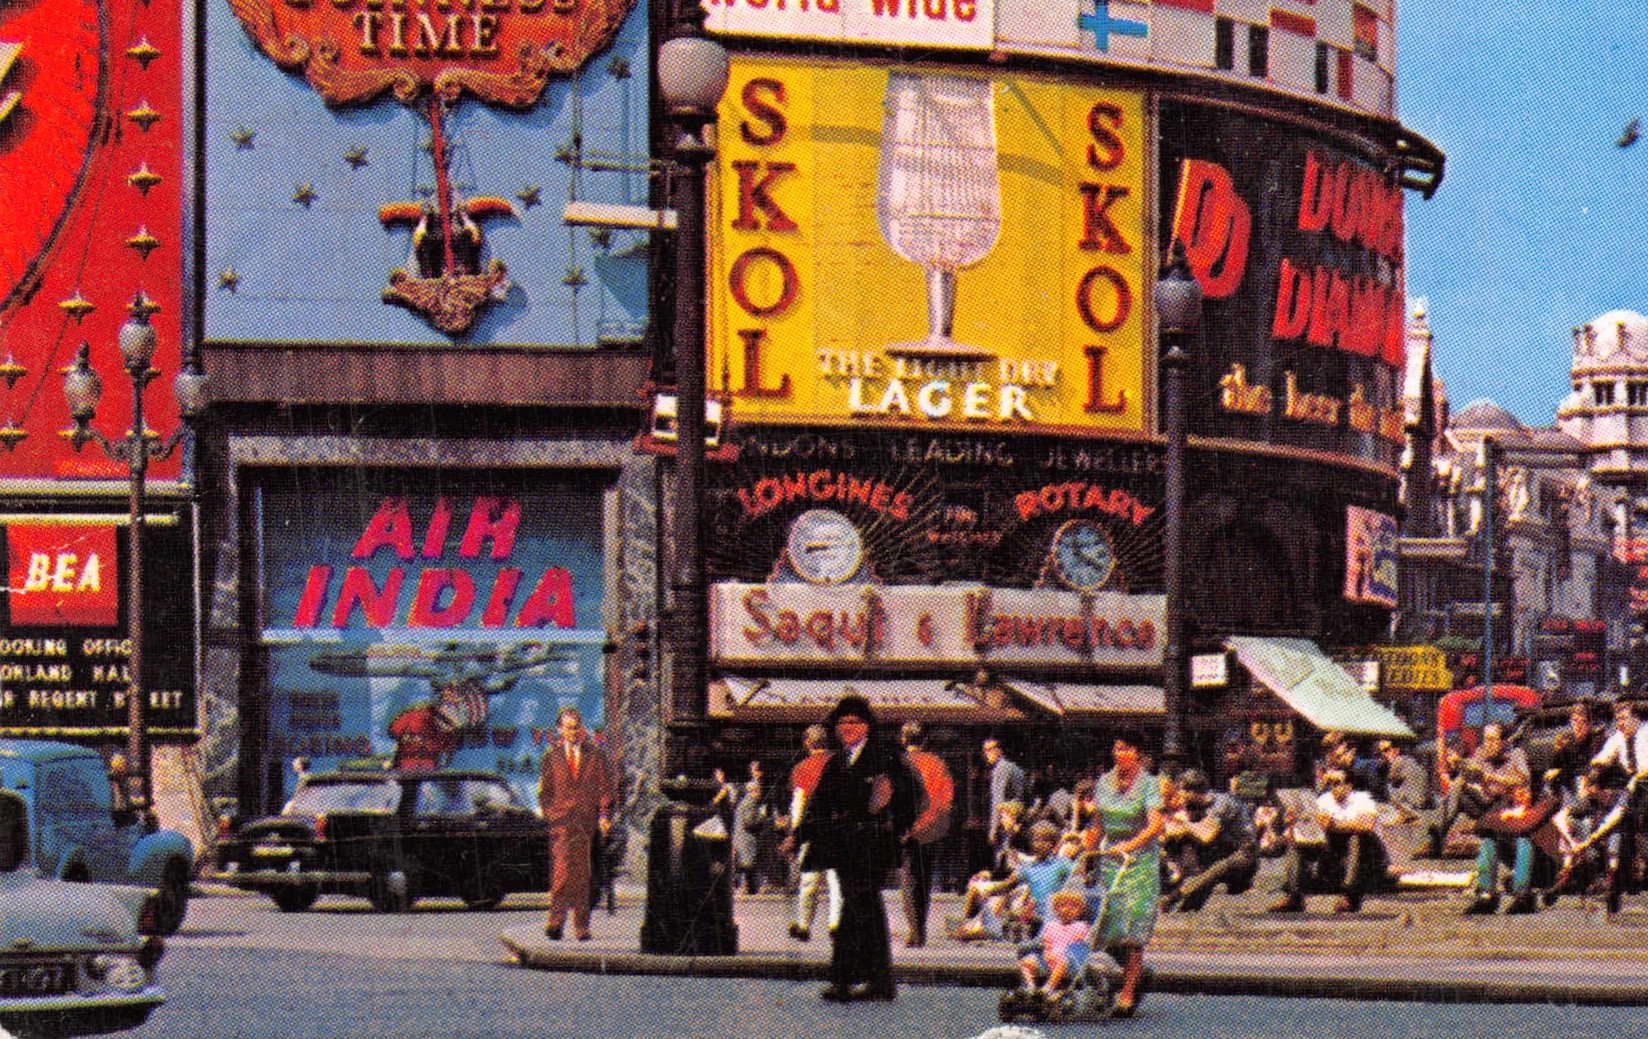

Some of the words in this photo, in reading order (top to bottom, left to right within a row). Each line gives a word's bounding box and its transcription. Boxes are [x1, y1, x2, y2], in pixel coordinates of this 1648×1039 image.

[352, 13, 500, 58] TIME
[729, 77, 801, 401] SKOL
[1075, 102, 1134, 416] SKOL
[817, 348, 884, 376] THE
[998, 356, 1059, 384] DRY
[849, 376, 1034, 421] LAGER
[1044, 442, 1165, 471] JEWELLER
[737, 470, 914, 521] LONGINES
[1014, 481, 1154, 528] ROTARY
[350, 493, 522, 559] AIR
[26, 551, 101, 593] BEA
[291, 562, 578, 629] INDIA
[82, 638, 133, 656] OFFIC
[92, 664, 133, 683] HAL
